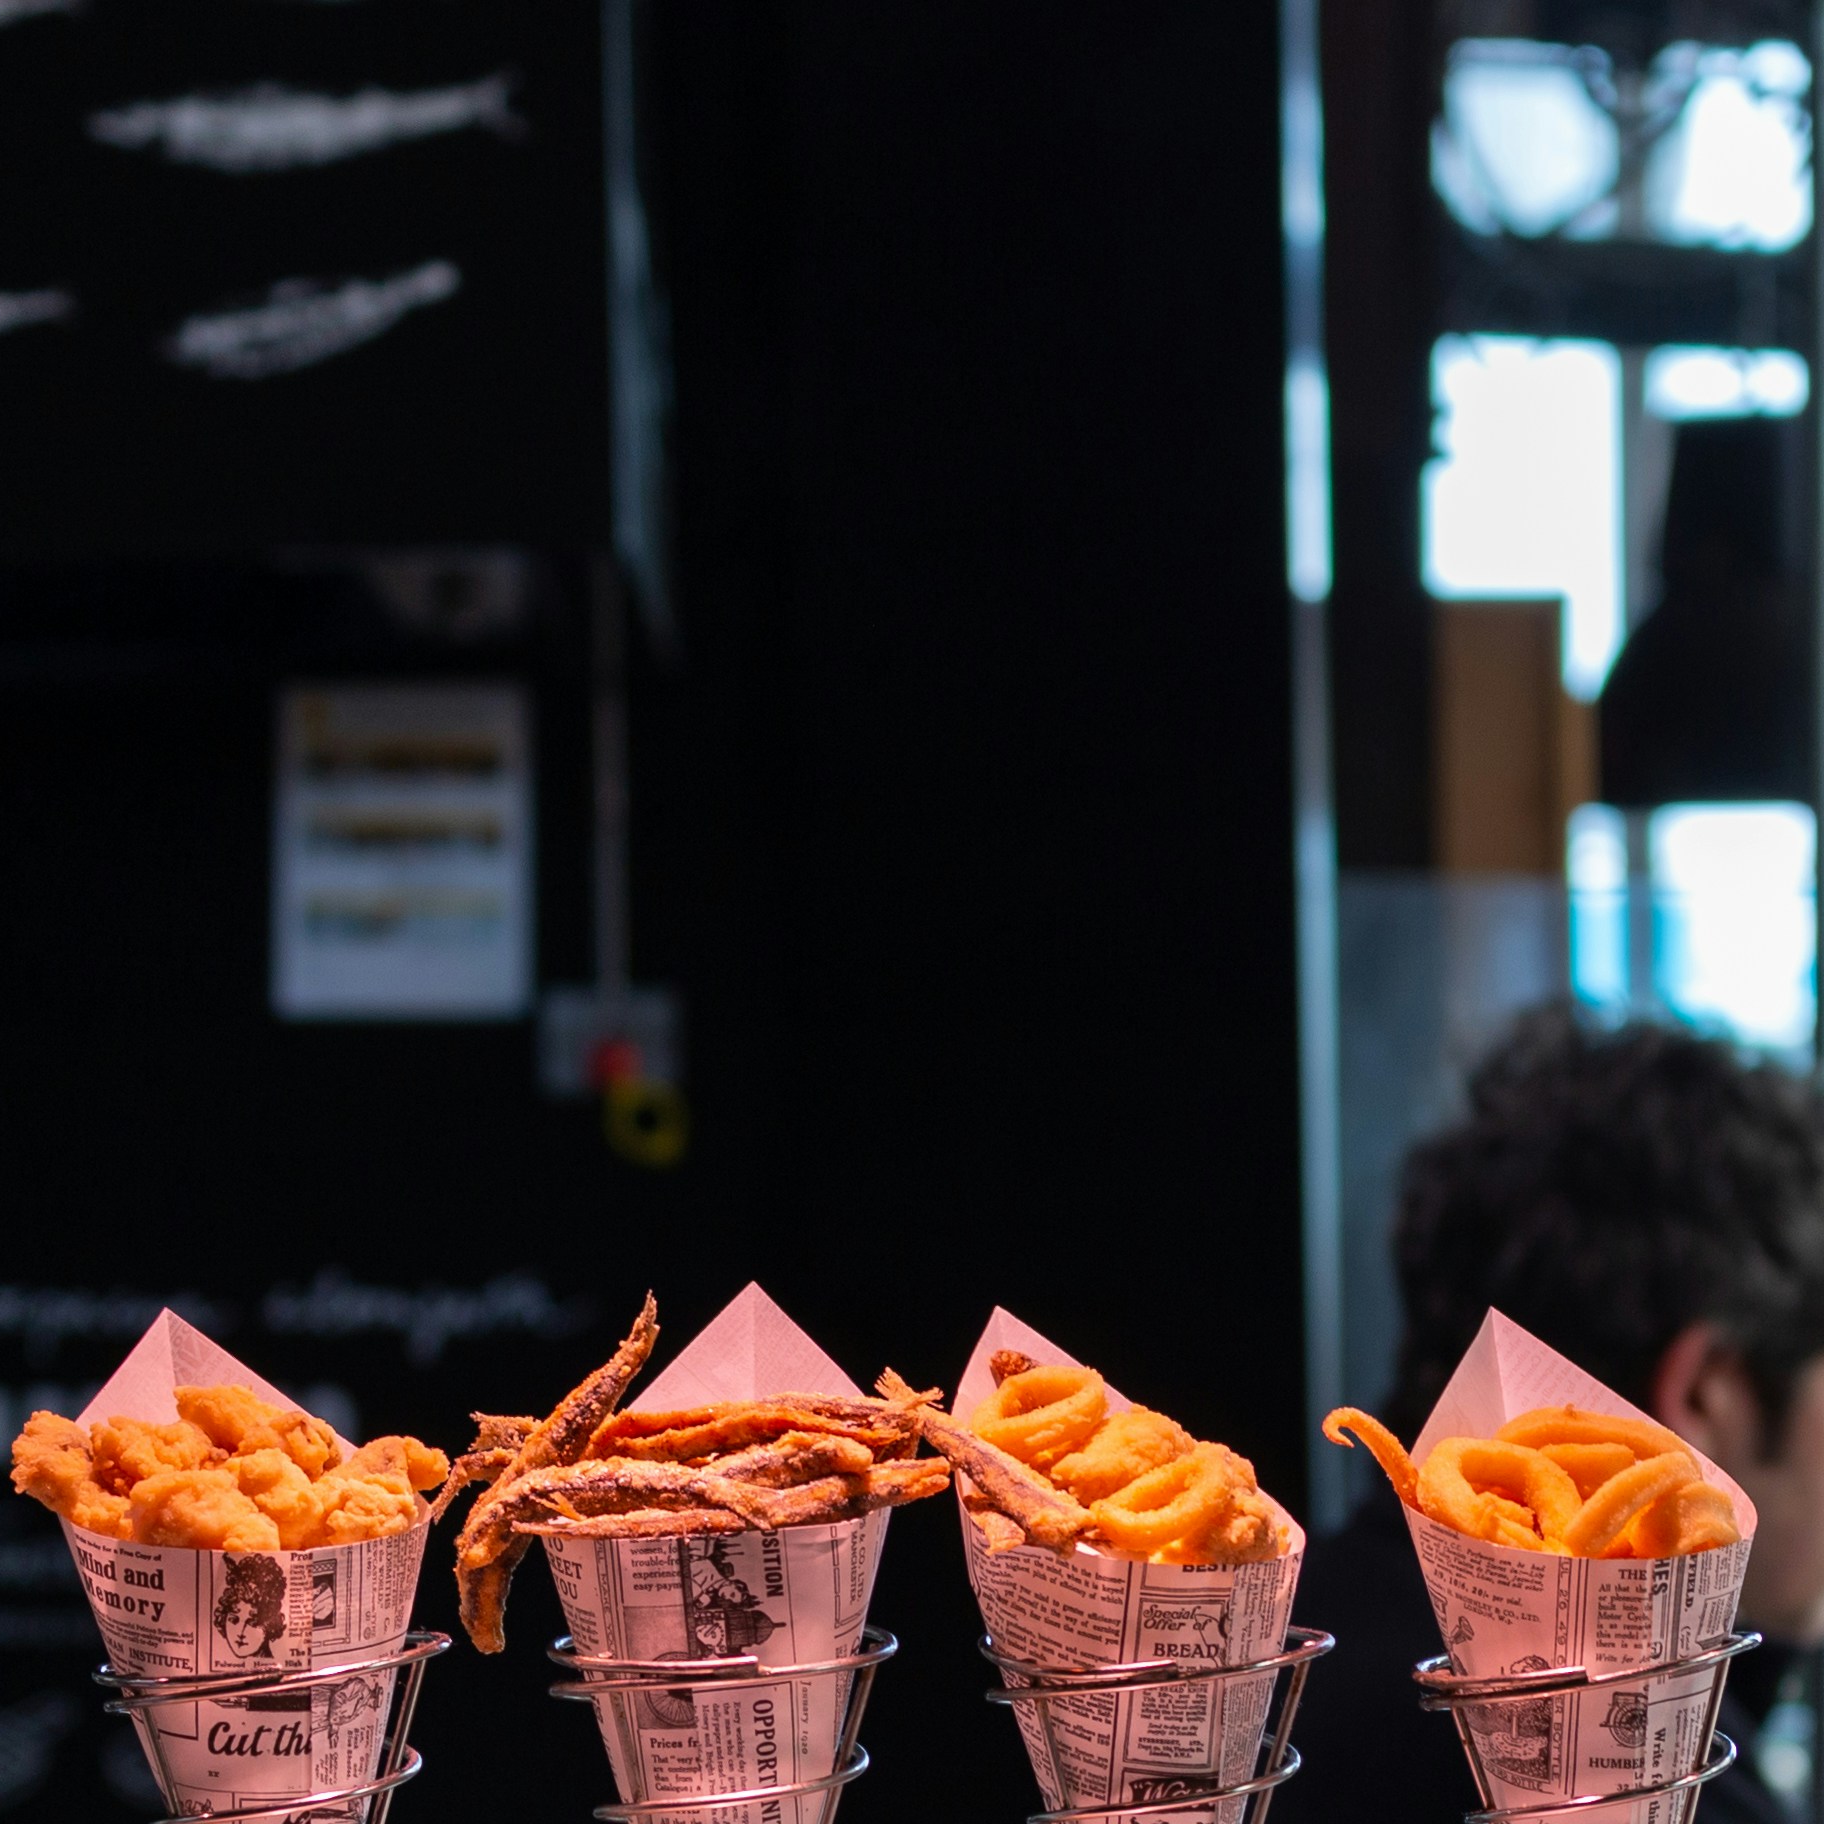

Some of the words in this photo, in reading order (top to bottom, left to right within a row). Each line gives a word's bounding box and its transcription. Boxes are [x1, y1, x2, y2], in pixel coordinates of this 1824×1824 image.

[124, 1567, 165, 1591] and
[1618, 1569, 1648, 1581] THE
[1143, 1604, 1197, 1620] Special
[1143, 1618, 1186, 1632] Offer
[1192, 1618, 1212, 1632] of
[1153, 1643, 1219, 1659] BREAD
[208, 1721, 267, 1756] Cut
